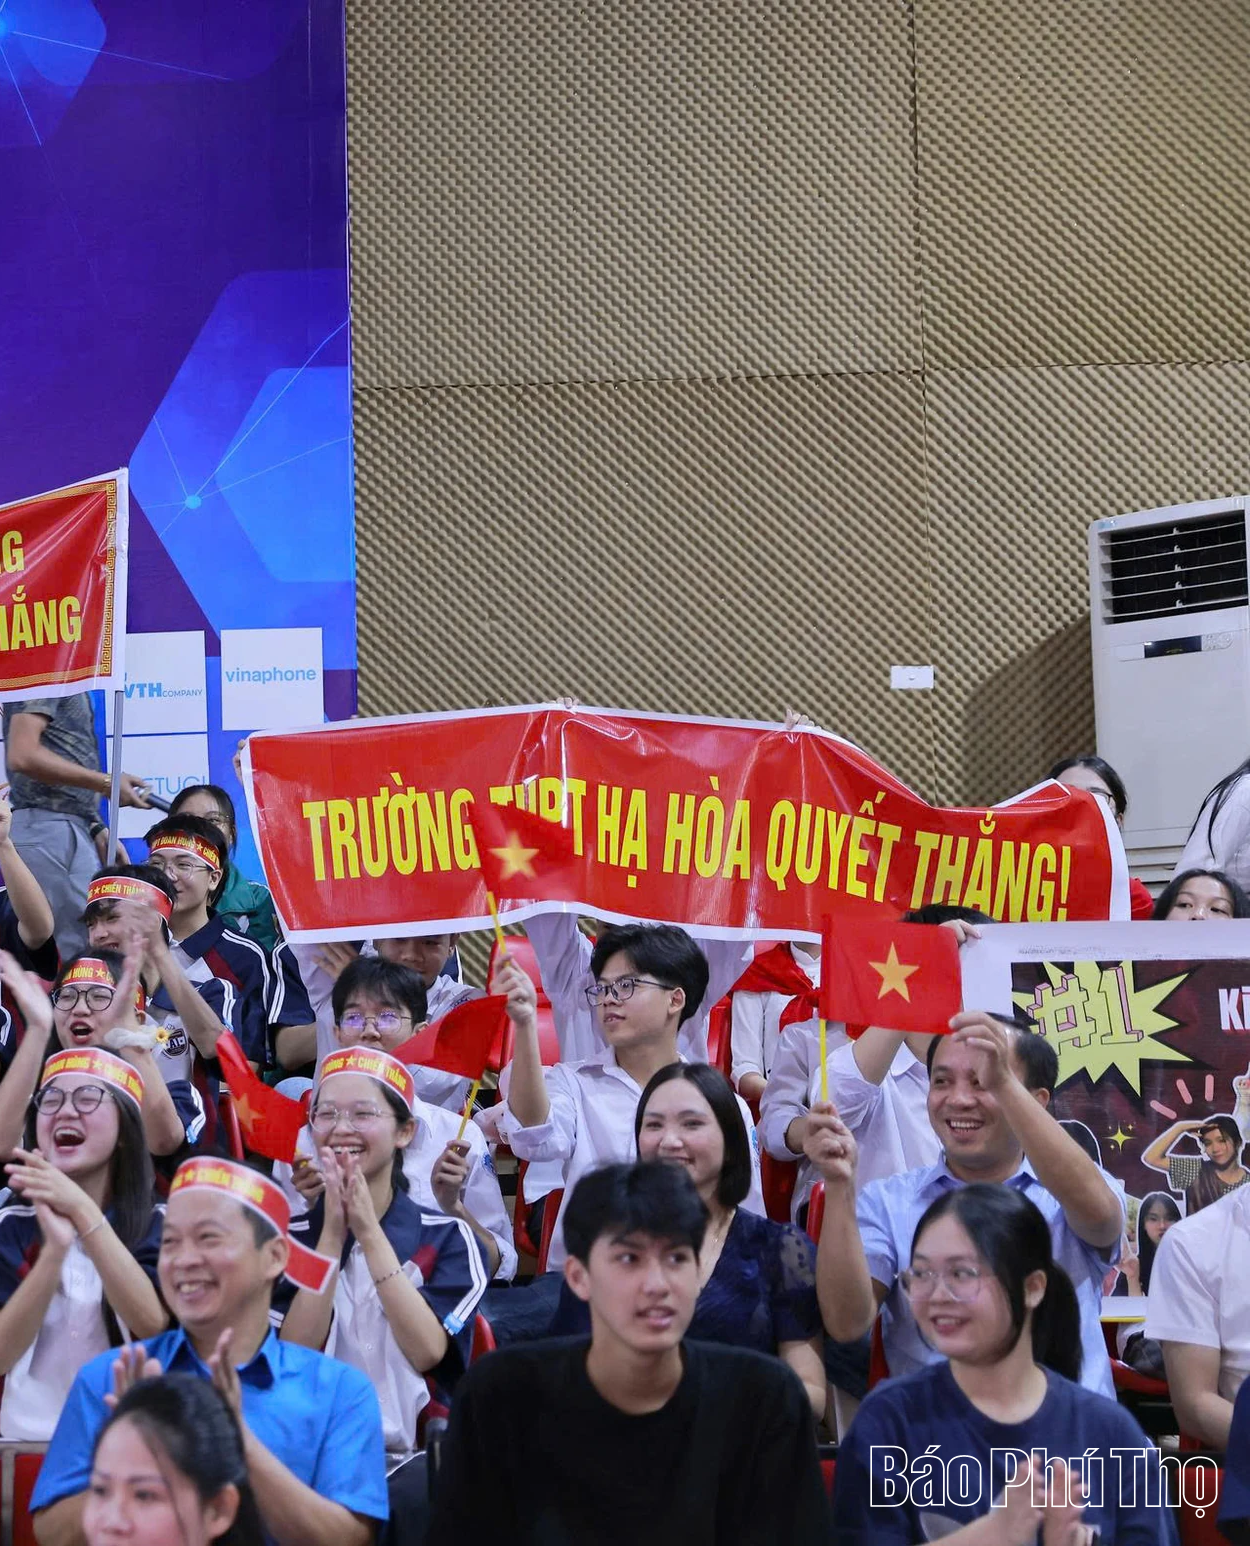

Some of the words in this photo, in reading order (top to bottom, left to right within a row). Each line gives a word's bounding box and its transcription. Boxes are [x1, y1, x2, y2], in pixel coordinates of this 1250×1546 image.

[225, 667, 317, 684] vinaphone
[302, 772, 481, 882] TRƯỜNG
[489, 777, 587, 857] PT
[597, 784, 648, 888] HẠ
[662, 776, 751, 880] HÒA
[765, 792, 901, 903] QUYẾT
[907, 811, 1071, 922] THẮNG!
[1027, 966, 1144, 1056] #1
